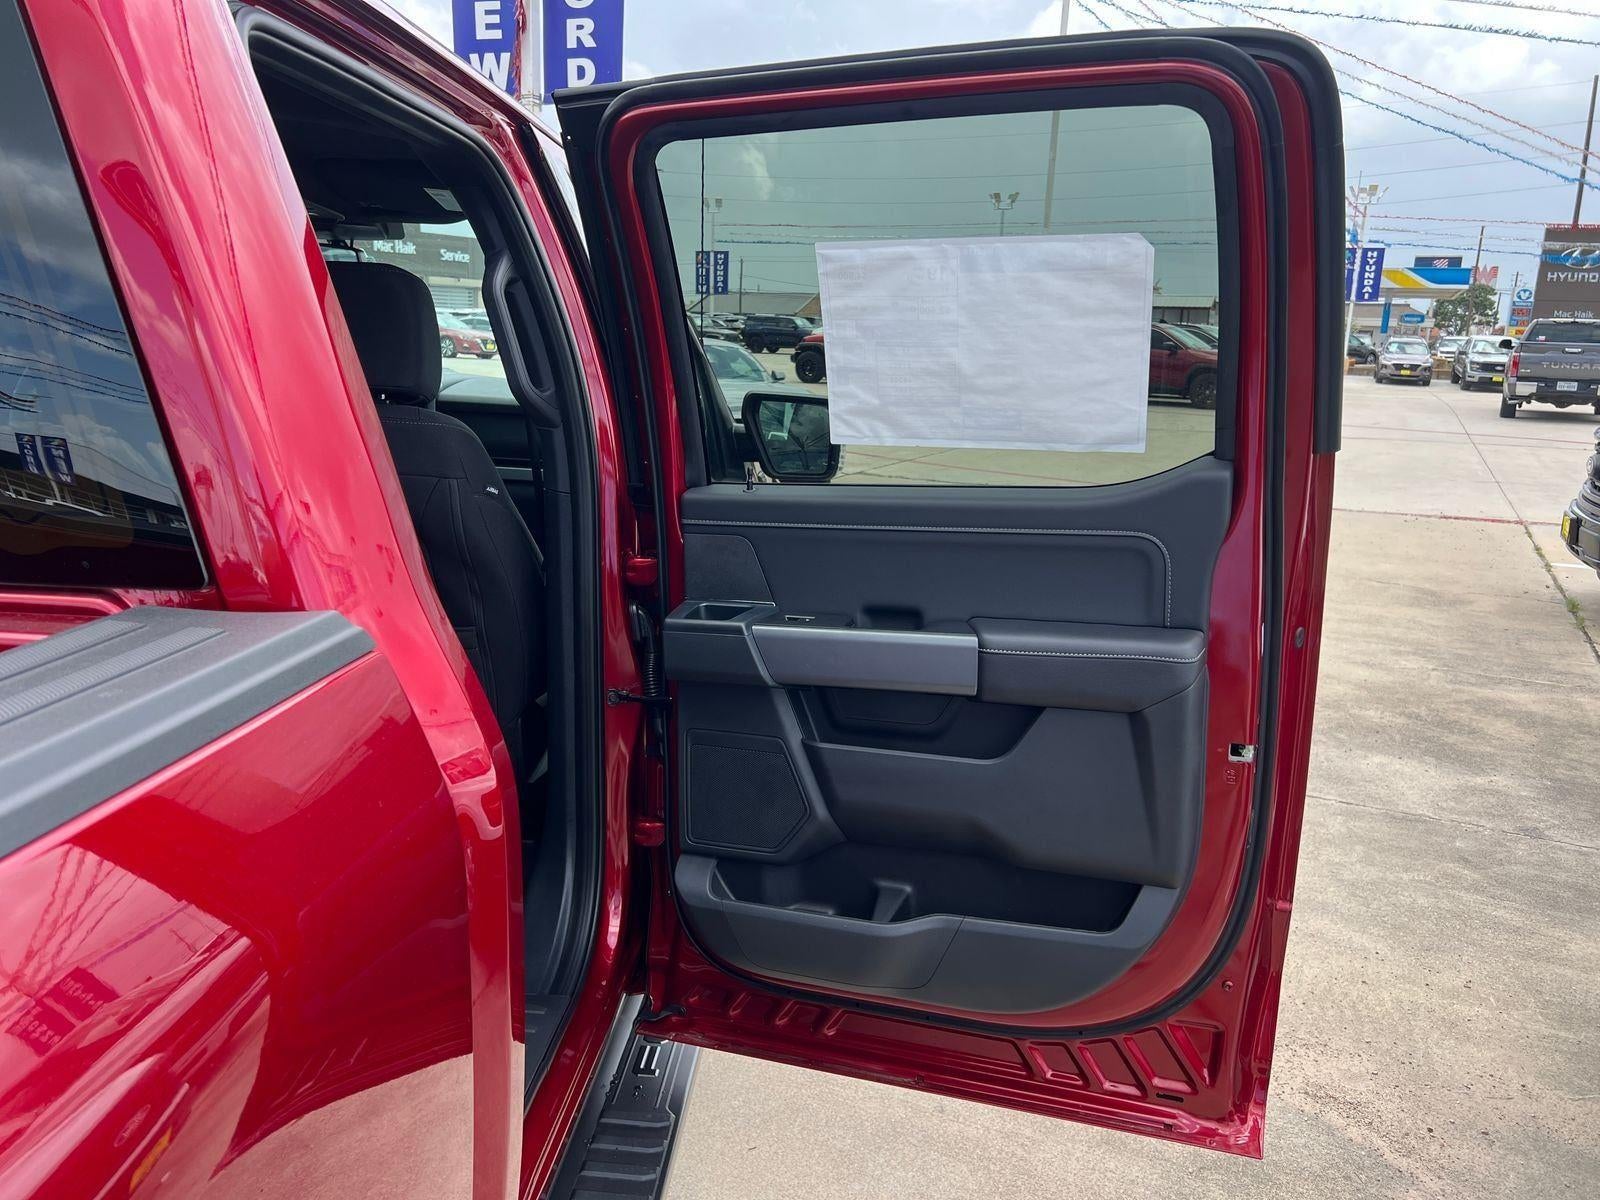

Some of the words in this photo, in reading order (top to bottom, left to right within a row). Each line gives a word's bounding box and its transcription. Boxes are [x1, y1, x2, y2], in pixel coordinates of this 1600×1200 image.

[469, 0, 511, 92] EW
[373, 240, 394, 253] Mac
[395, 240, 417, 255] Haik
[440, 249, 471, 263] Service
[716, 253, 725, 293] HYUNDAI
[1362, 251, 1378, 300] HYUNDAI
[1547, 272, 1600, 282] HYUND
[1553, 310, 1571, 318] Mac
[1574, 310, 1594, 318] Haik
